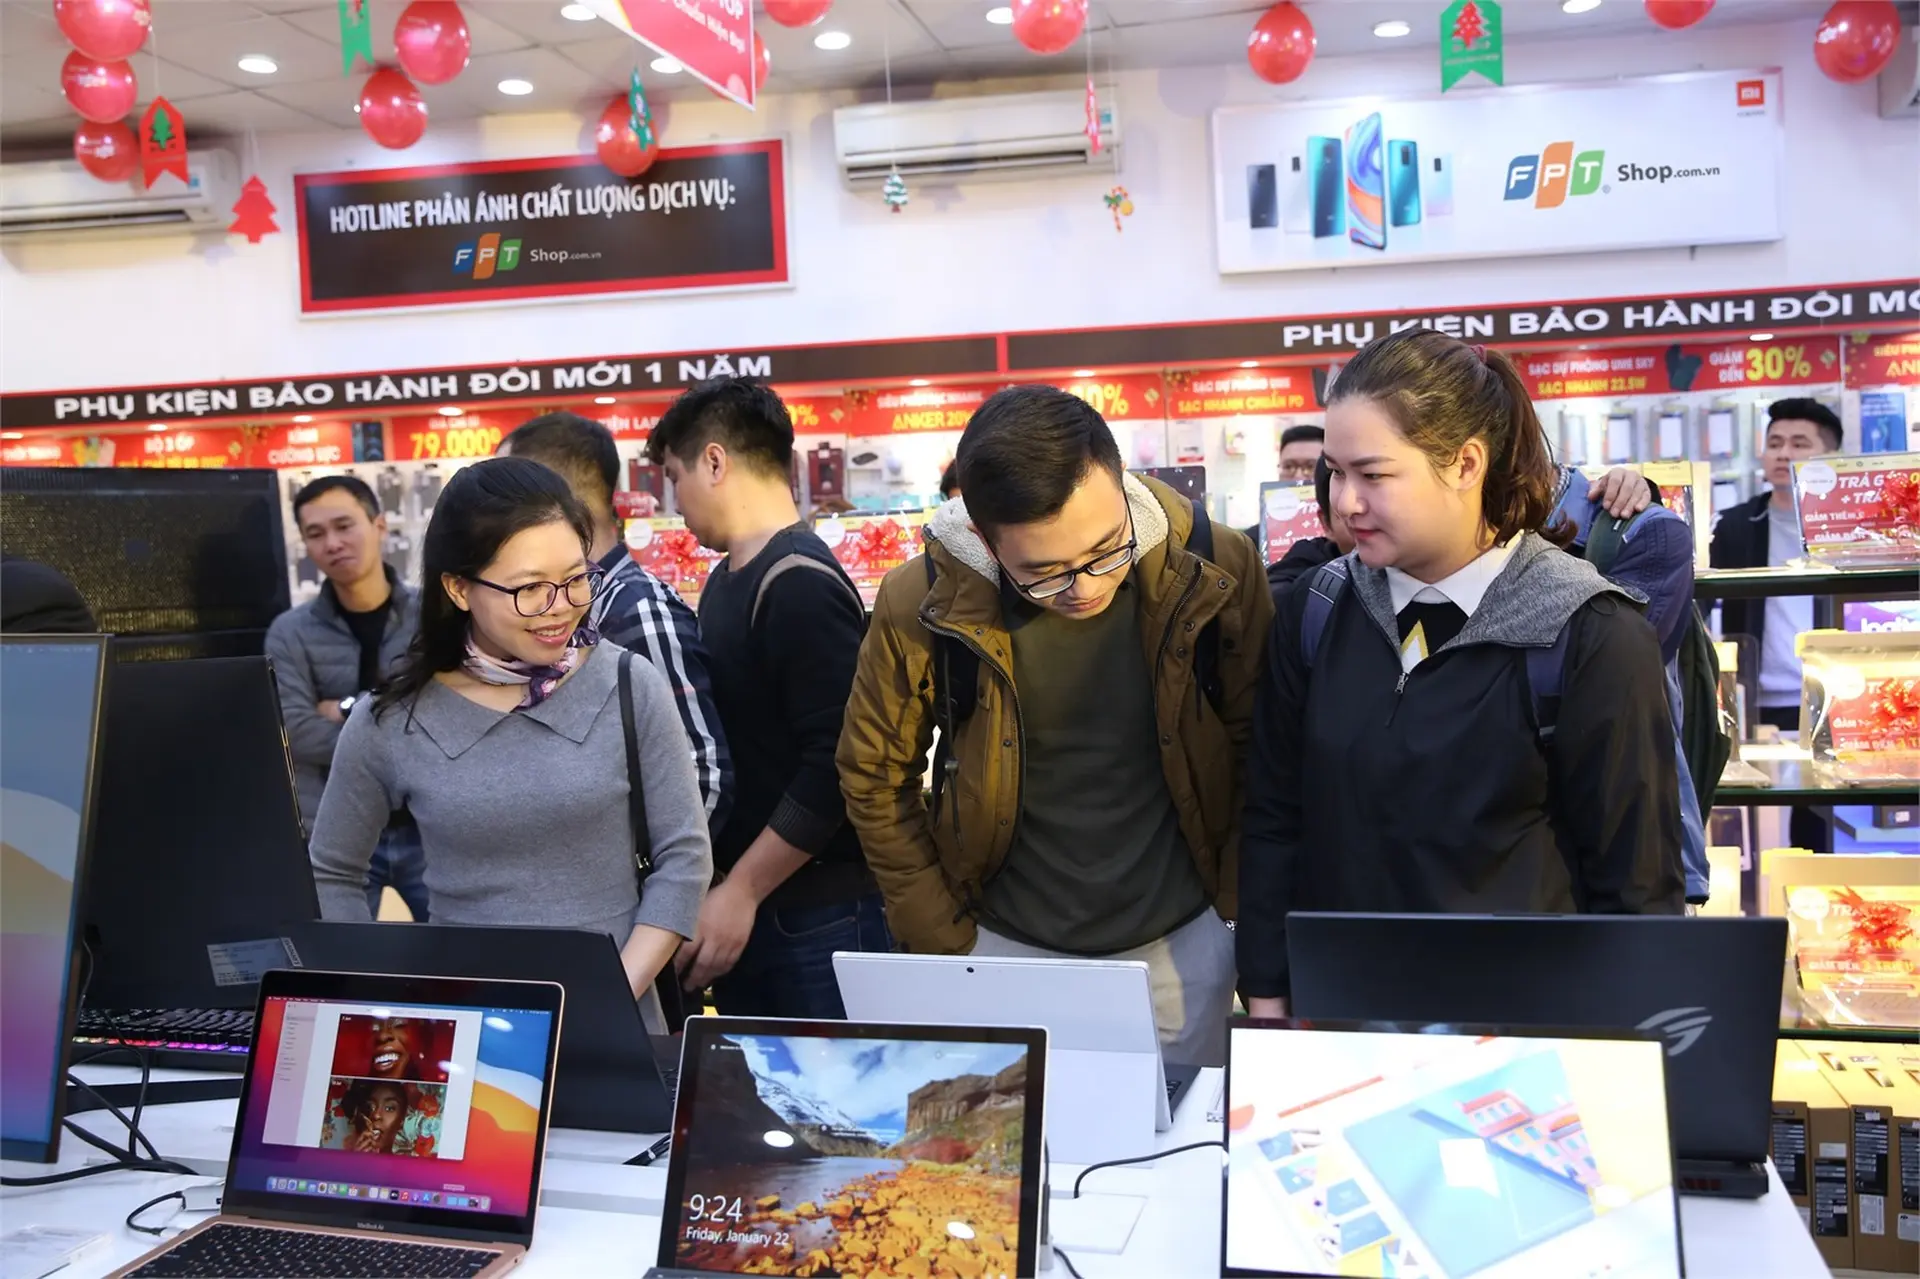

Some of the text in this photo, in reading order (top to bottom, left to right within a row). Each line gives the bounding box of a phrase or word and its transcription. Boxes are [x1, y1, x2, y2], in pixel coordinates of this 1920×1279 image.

[1617, 162, 1721, 184] Shop.com.vn
[330, 178, 736, 233] HOTLINE PHẢN ÁNH CHẤT LƯỢNG DỊCH VỤ:
[1283, 321, 1373, 348] PHỤ
[1509, 306, 1609, 335] BẢO
[1623, 299, 1755, 329] HÀNH
[1746, 345, 1812, 382] 30%
[55, 394, 135, 420] PHỤ
[147, 388, 237, 416] KIỆN
[249, 381, 334, 409] BẢO
[345, 374, 458, 403] HÀNH
[552, 360, 632, 389] MỚI
[645, 361, 662, 383] 1
[679, 354, 772, 381] NĂM
[892, 411, 945, 432] ANKER
[1839, 472, 1870, 488] TRẢ
[689, 1193, 743, 1222] 9:24
[686, 1226, 790, 1247] Friday, January 22
